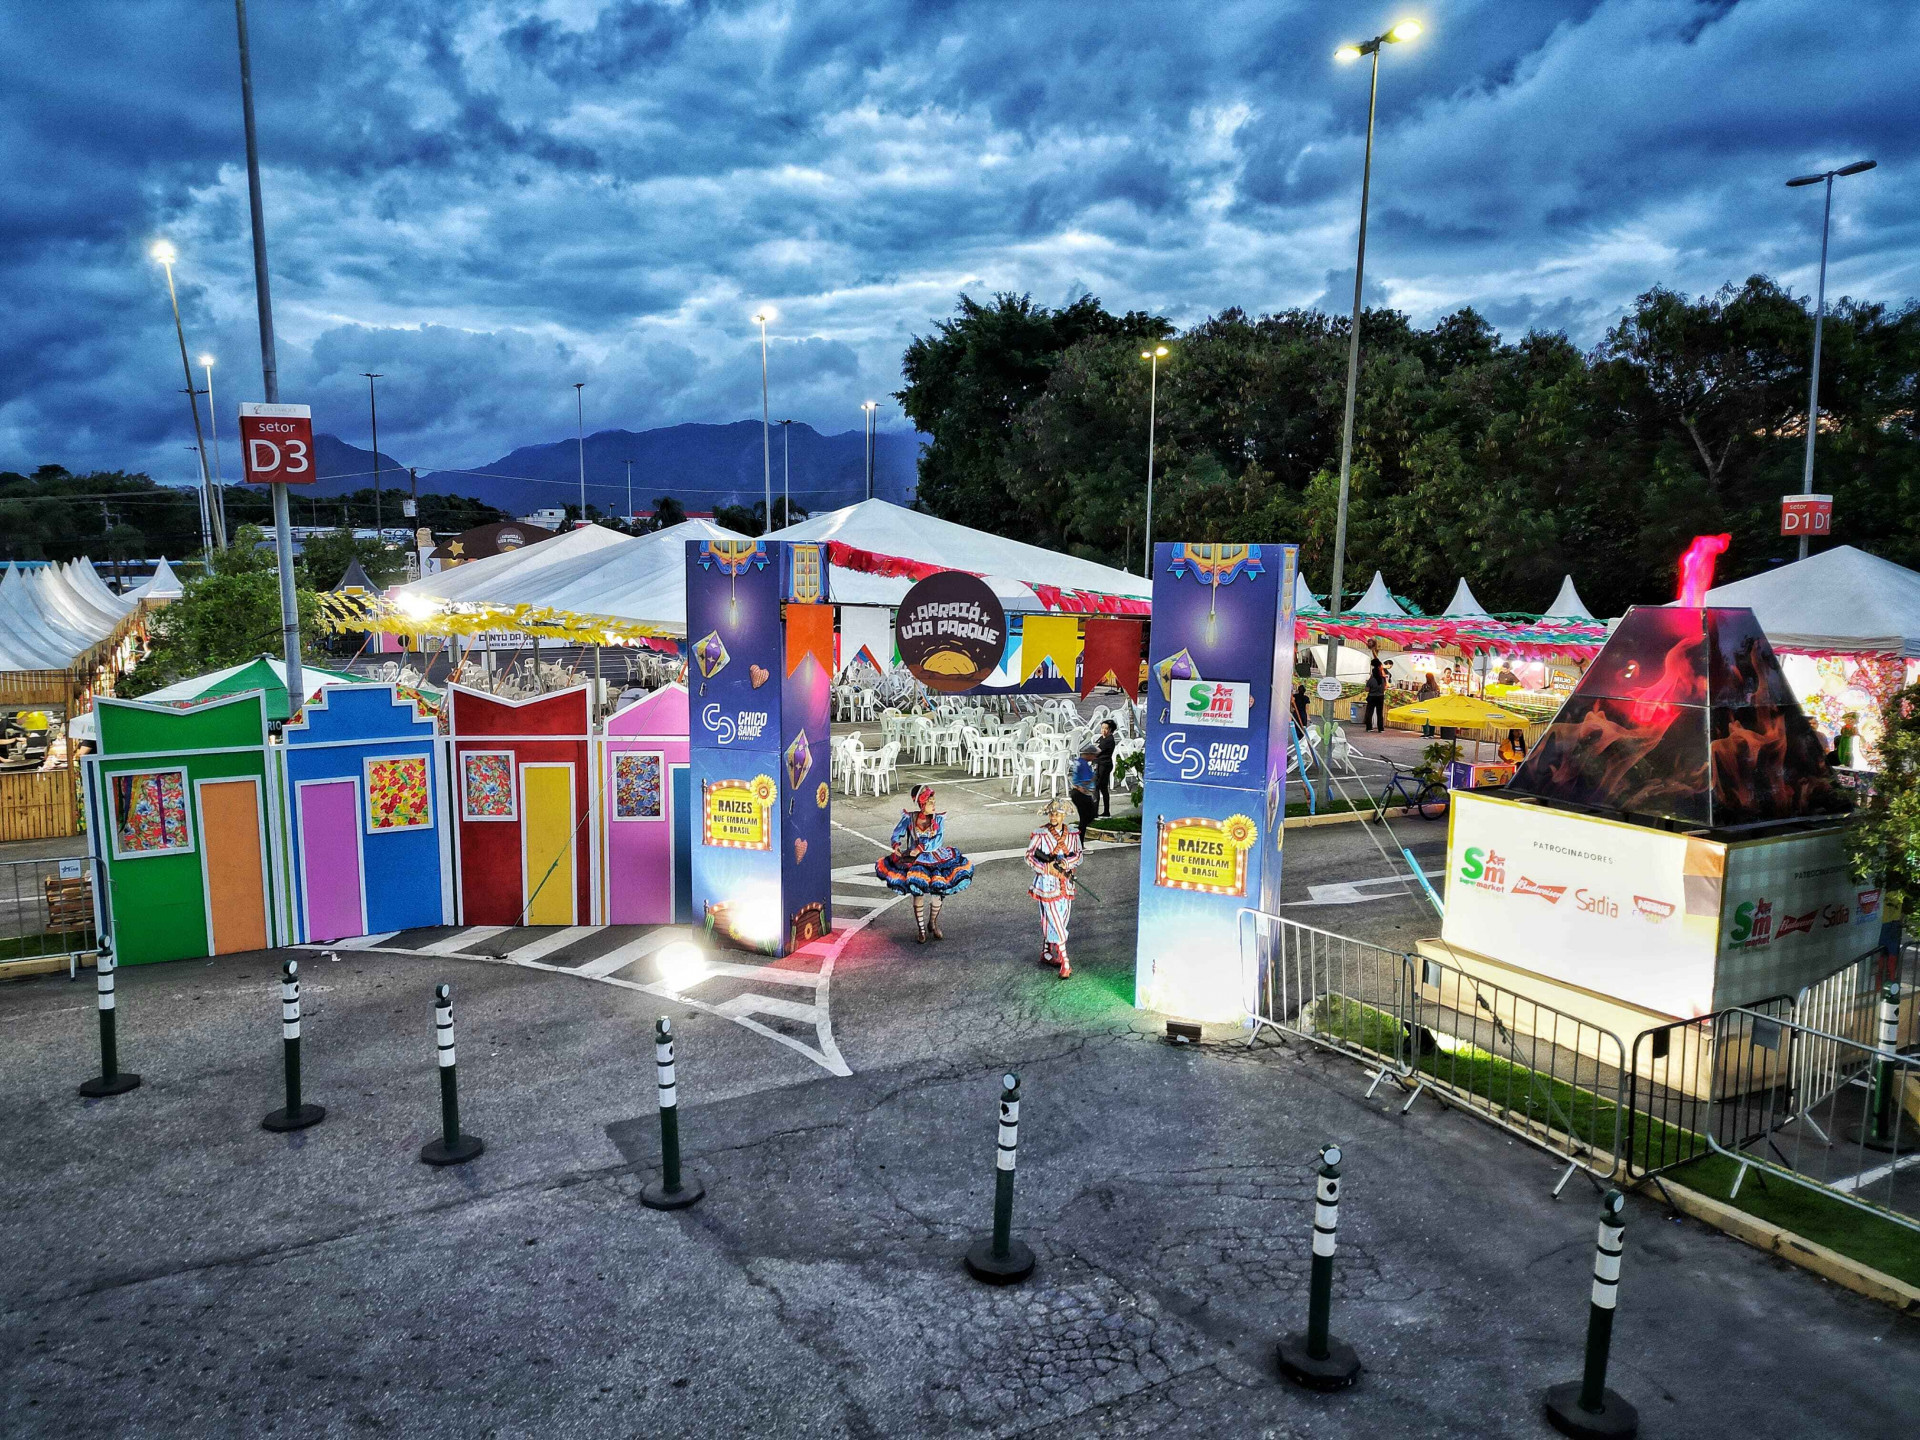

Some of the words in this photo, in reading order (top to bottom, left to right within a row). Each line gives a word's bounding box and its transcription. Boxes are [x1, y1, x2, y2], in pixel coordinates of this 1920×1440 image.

[259, 422, 296, 433] setor
[249, 439, 309, 473] D3
[1784, 512, 1810, 530] D1
[1814, 512, 1831, 530] D1
[917, 601, 981, 622] ARRAIÁ
[509, 633, 522, 641] DA
[901, 620, 934, 640] VIA
[937, 620, 1000, 645] PARQUE
[737, 710, 768, 727] CHICO
[737, 725, 763, 737] SANDE
[1208, 742, 1249, 761] CHICO
[1207, 759, 1241, 773] SANDE
[718, 798, 753, 814] RAÍZES
[714, 814, 724, 823] QUE
[726, 816, 758, 826] EMBALAM
[723, 825, 728, 833] O
[729, 825, 751, 835] BRASIL
[1178, 837, 1224, 856] RAÍZES
[1170, 854, 1185, 864] QUE
[1188, 855, 1230, 869] EMBALAM
[1182, 866, 1189, 874] O
[1191, 866, 1219, 878] BRASIL
[1575, 888, 1619, 919] Sadia
